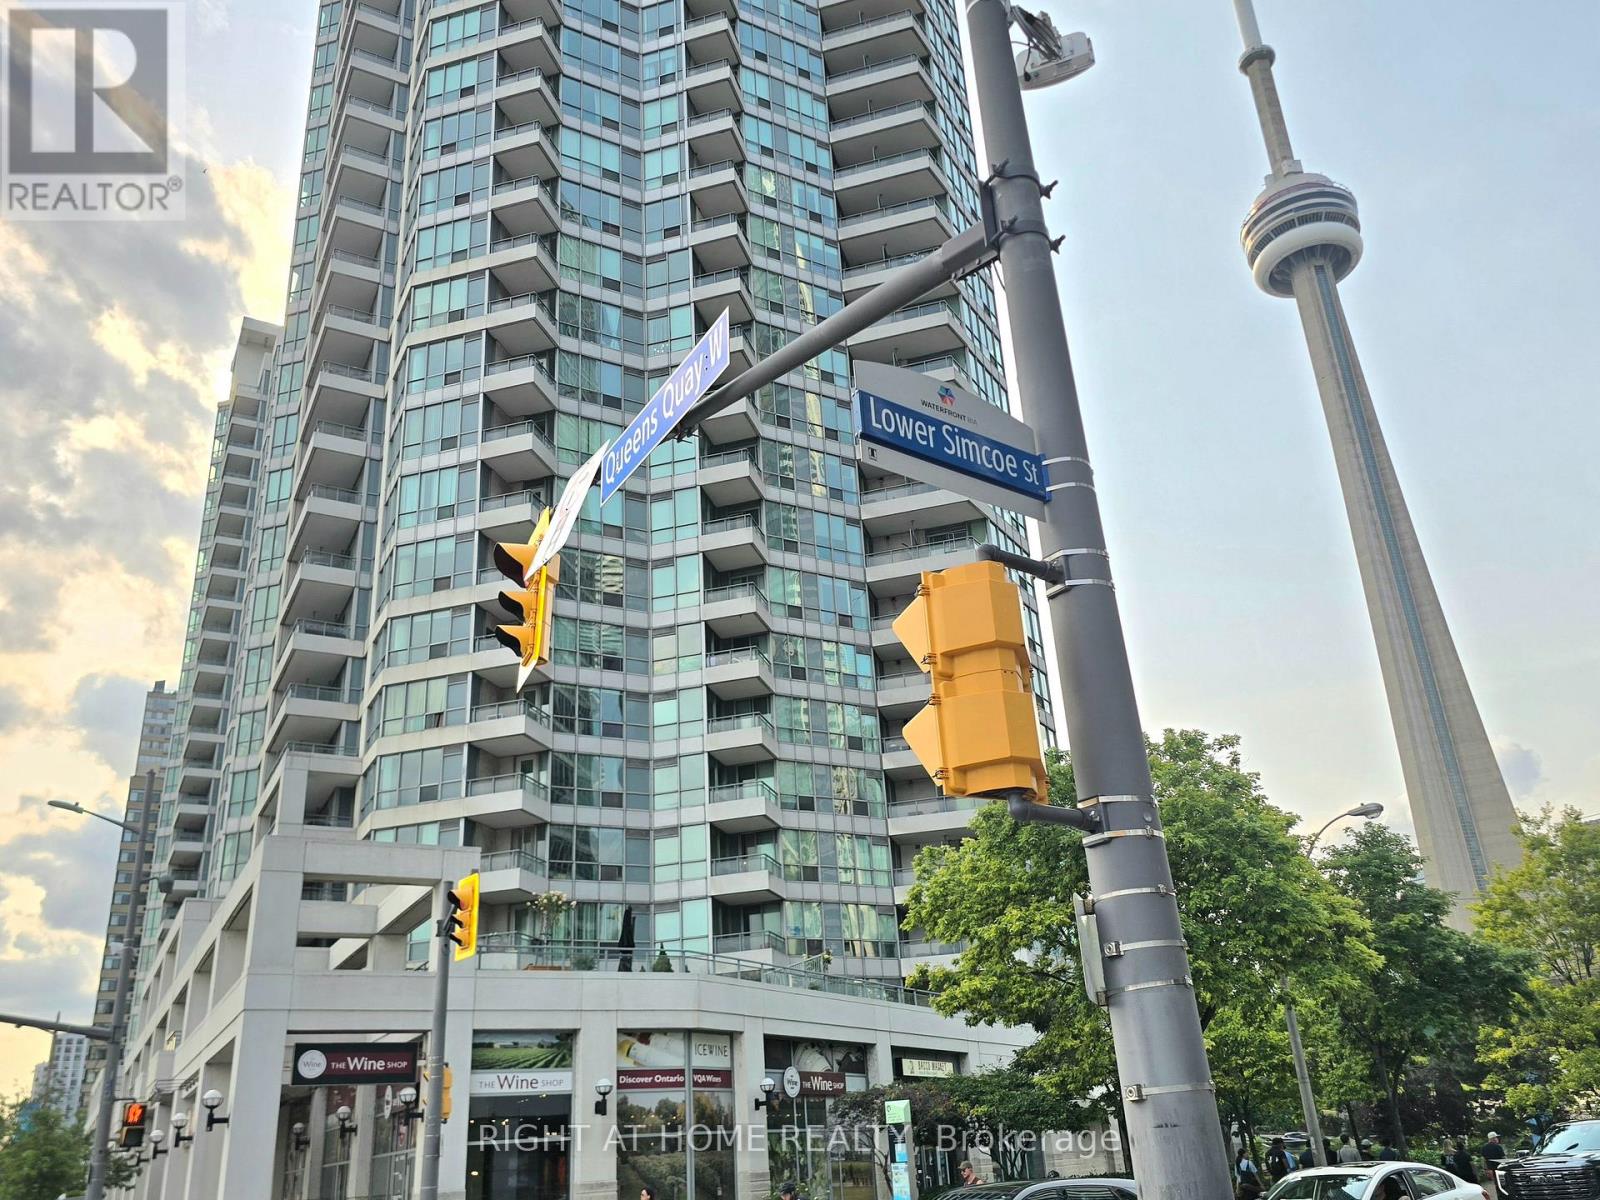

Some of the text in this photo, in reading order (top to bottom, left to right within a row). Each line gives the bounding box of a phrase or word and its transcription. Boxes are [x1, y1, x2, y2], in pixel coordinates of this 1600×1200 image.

[605, 322, 723, 484] Queens Quay W
[920, 399, 967, 422] WATERFRONT
[869, 396, 1039, 485] Lower Simcoe St
[694, 1043, 728, 1057] ICEWINE
[347, 1057, 385, 1071] Wine
[387, 1061, 407, 1069] SHOP
[479, 1074, 564, 1090] THE Wine SHOP
[619, 1075, 653, 1084] Discover
[654, 1074, 684, 1083] Ontario
[693, 1075, 706, 1083] VQA
[802, 1081, 812, 1089] THE
[811, 1075, 833, 1091] Wine
